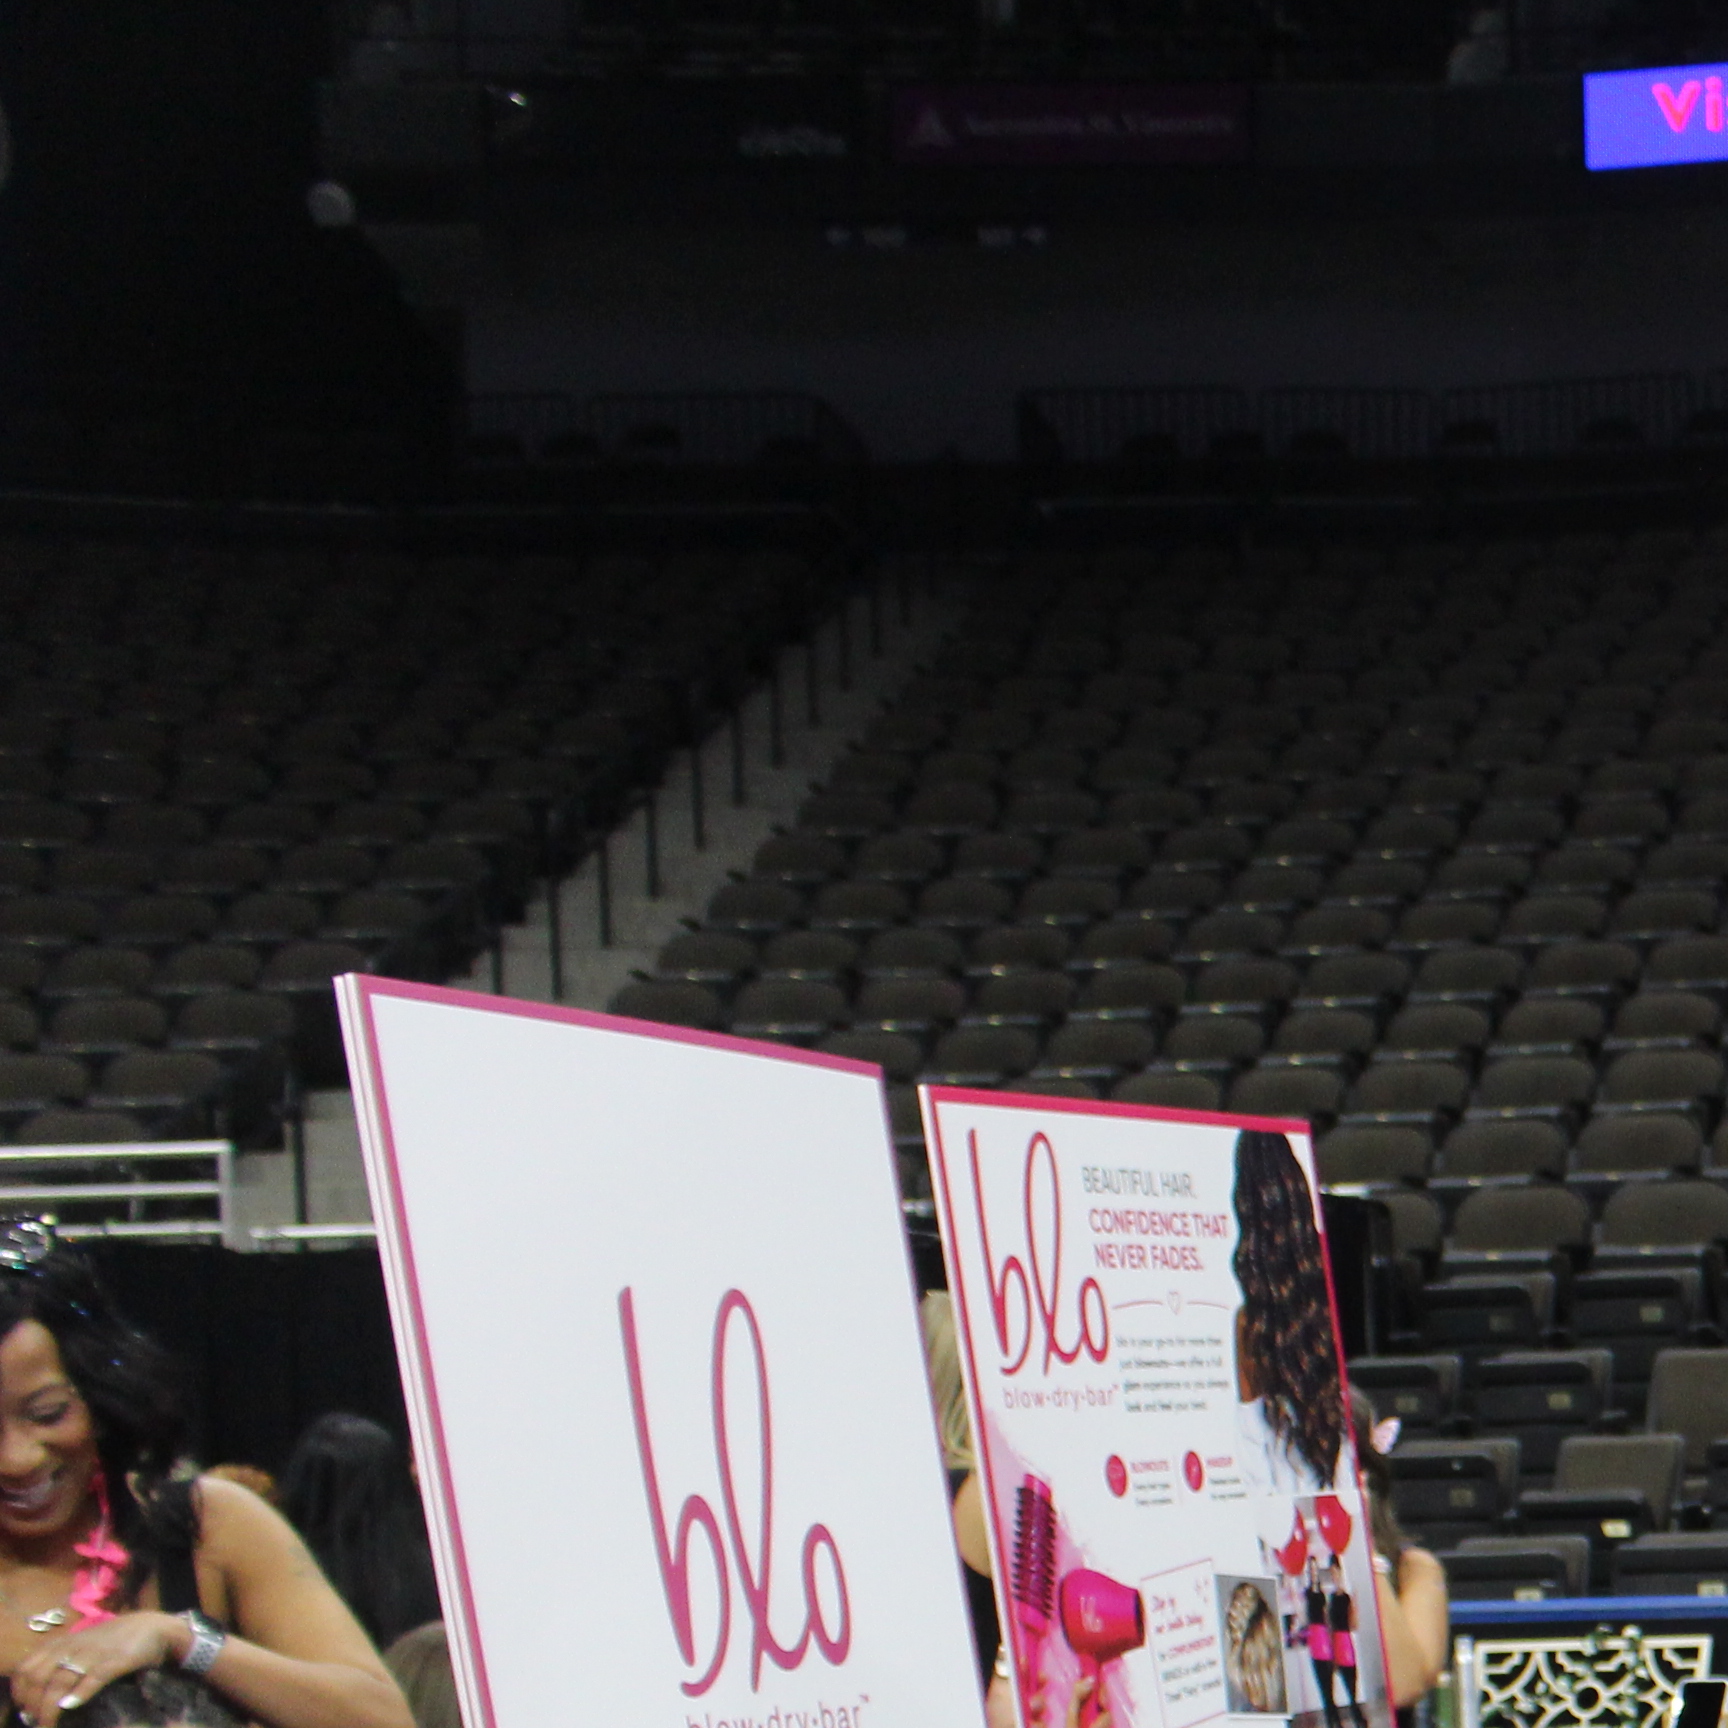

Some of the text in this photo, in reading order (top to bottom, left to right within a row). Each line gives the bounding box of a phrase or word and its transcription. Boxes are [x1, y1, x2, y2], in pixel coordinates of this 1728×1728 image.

[1081, 1166, 1159, 1198] BEAUTIFUL
[1088, 1207, 1229, 1238] CONFIDENCE THAT
[968, 1128, 1110, 1376] blo
[1093, 1243, 1205, 1272] NEVER FADES.
[617, 1285, 852, 1699] blo
